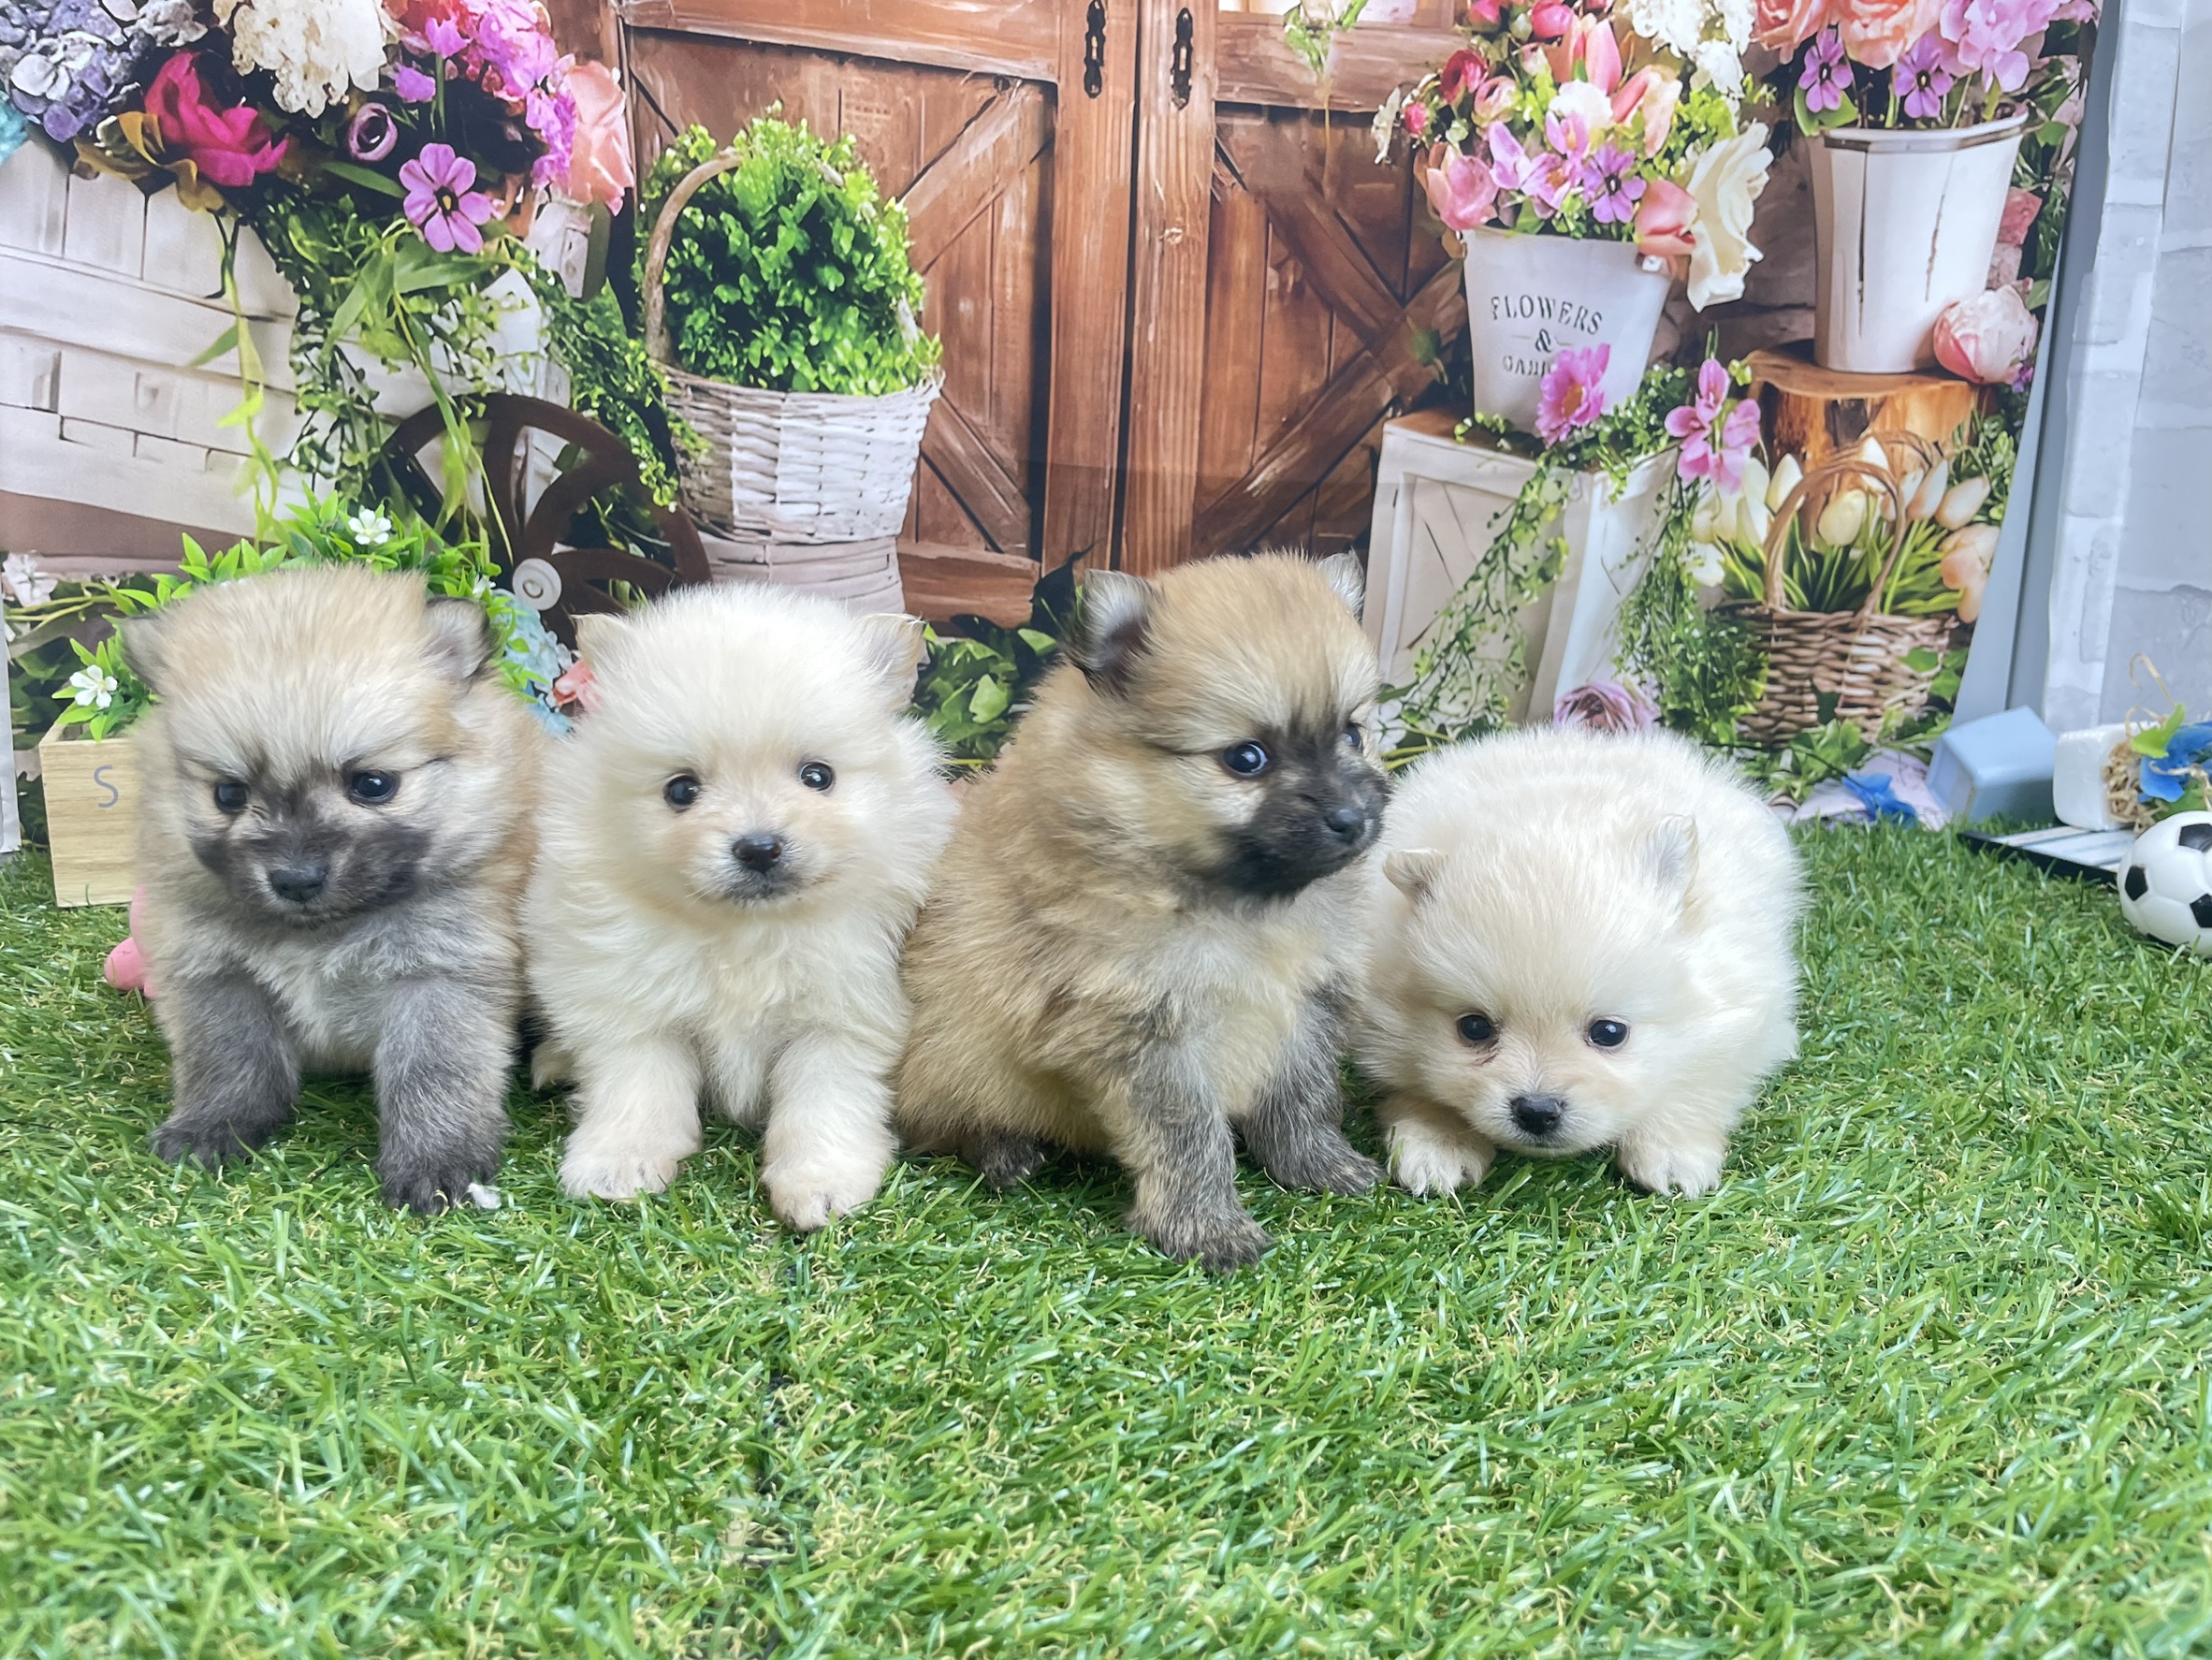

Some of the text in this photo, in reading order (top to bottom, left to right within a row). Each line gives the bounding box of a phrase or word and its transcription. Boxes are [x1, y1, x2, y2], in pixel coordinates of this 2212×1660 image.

[1491, 294, 1603, 335] FLOWERS
[1535, 328, 1552, 354] &
[94, 764, 119, 808] S
